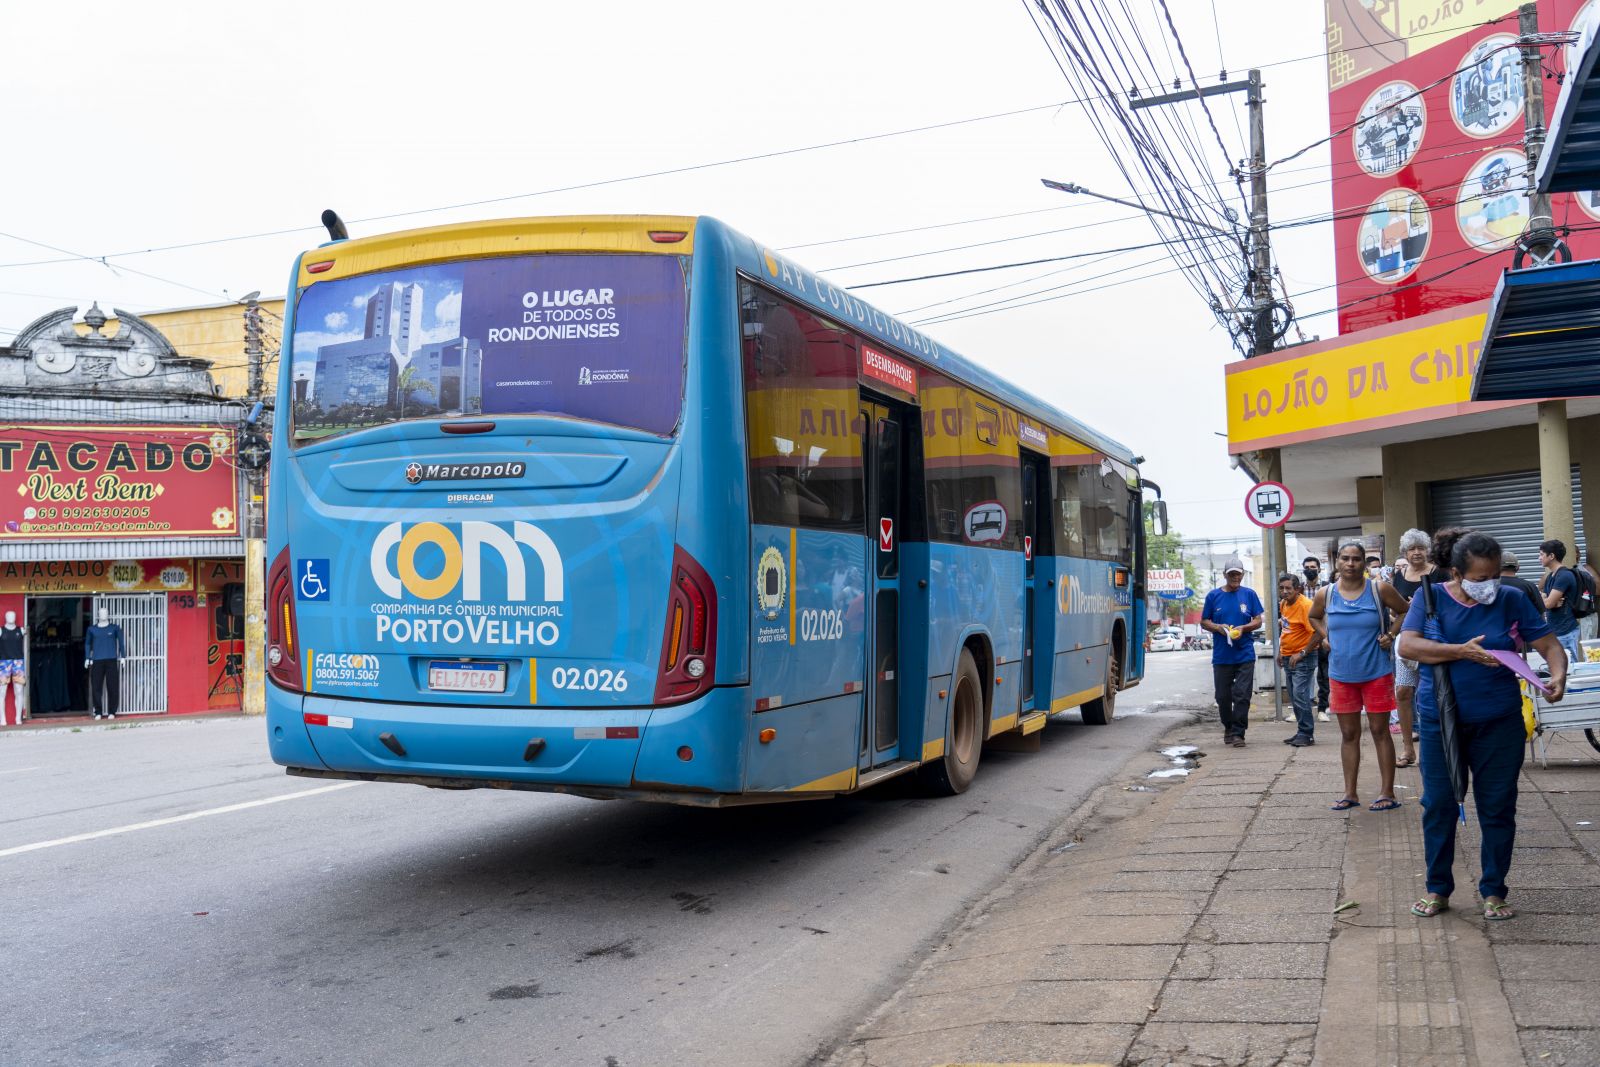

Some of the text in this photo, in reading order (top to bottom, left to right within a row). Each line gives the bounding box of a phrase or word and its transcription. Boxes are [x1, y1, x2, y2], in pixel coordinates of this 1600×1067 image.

[523, 288, 614, 308] O LUGAR
[523, 307, 616, 323] DE TODOS OS
[781, 259, 939, 359] AR CONDICIONADO
[488, 323, 620, 343] RONDONIENSES
[866, 350, 912, 384] DESEMBARQUE
[592, 373, 629, 381] RONDÔNIA
[1243, 368, 1328, 421] LOJÃO
[1348, 361, 1389, 399] DA
[426, 462, 522, 479] Marcopolo
[28, 473, 155, 501] Vest Bem
[38, 507, 150, 518] 69 992630205
[21, 521, 171, 533] @vestbem7setembro
[5, 560, 105, 577] ATACADO
[370, 600, 564, 617] COMPANHIA DE ÔNIBUS MUNICIPAL
[801, 609, 843, 641] 02.026
[758, 634, 788, 643] PORTO VELHO
[316, 668, 380, 680] 0800.591.5067
[552, 666, 628, 692] 02.026
